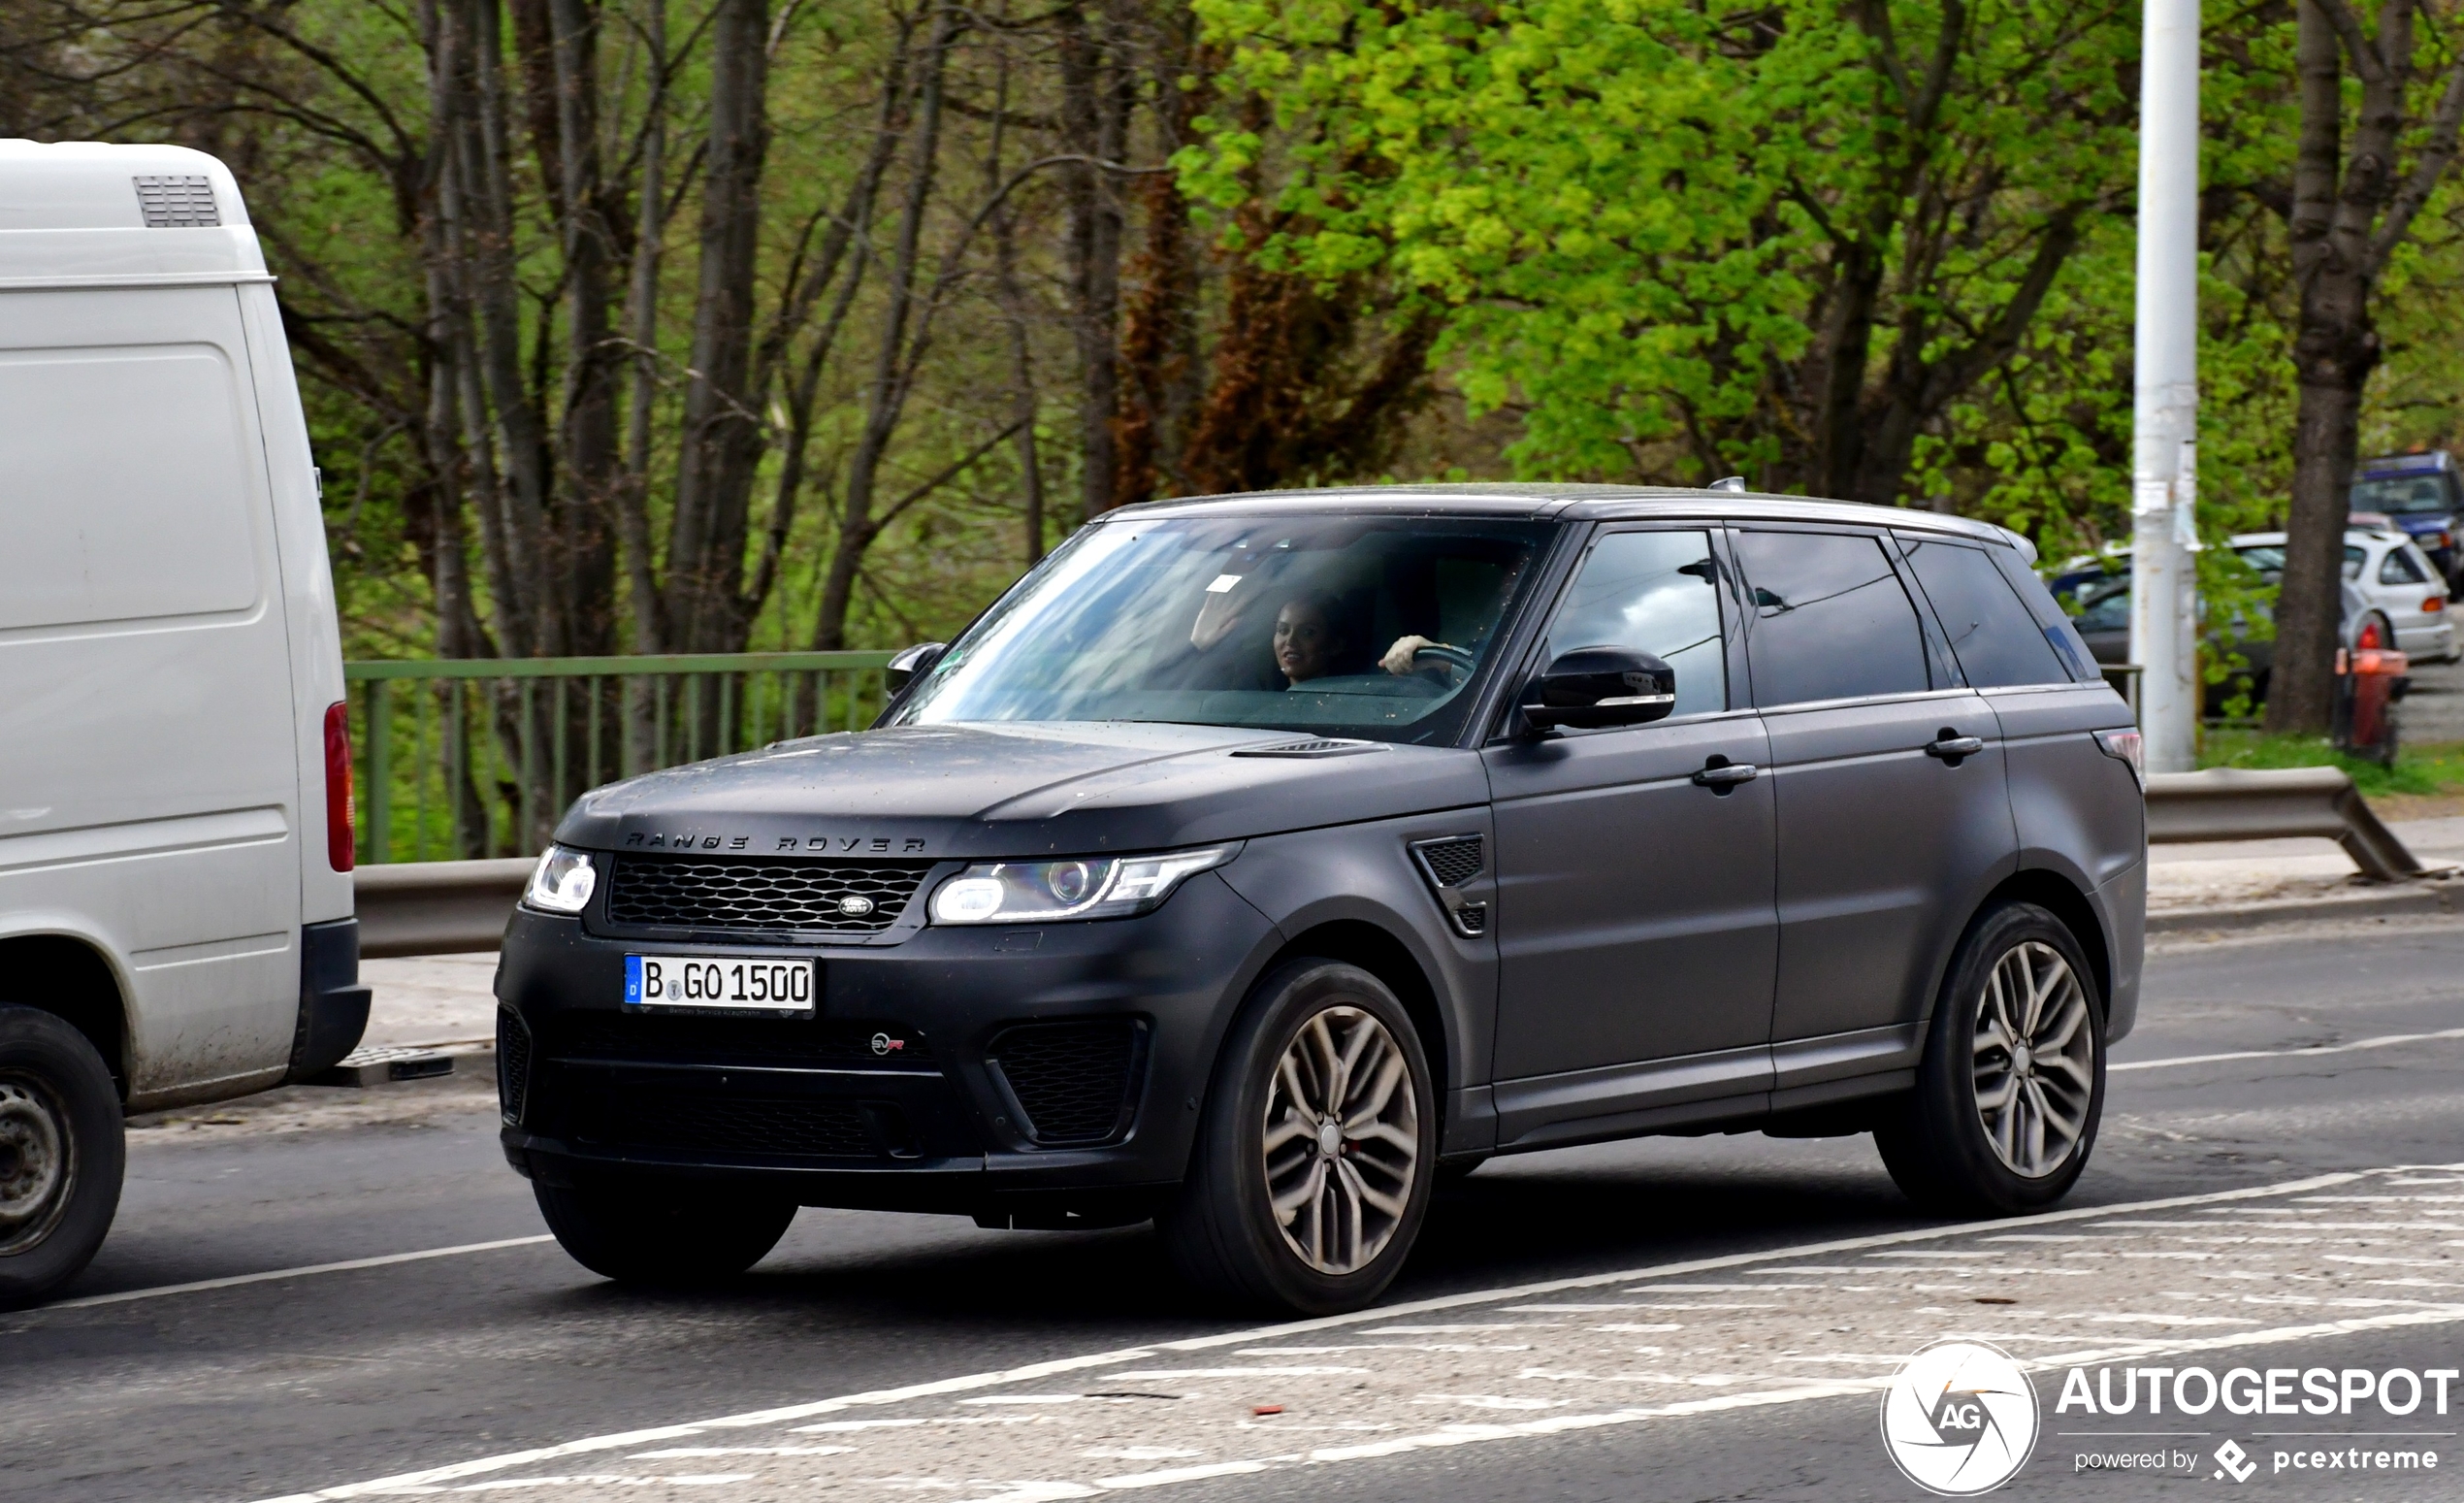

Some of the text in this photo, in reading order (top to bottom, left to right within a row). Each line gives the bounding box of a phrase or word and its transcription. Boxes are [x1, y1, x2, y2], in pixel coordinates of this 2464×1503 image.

[625, 832, 926, 853] RANGE ROVER
[630, 984, 636, 997] D
[645, 962, 809, 1002] B GO 1500
